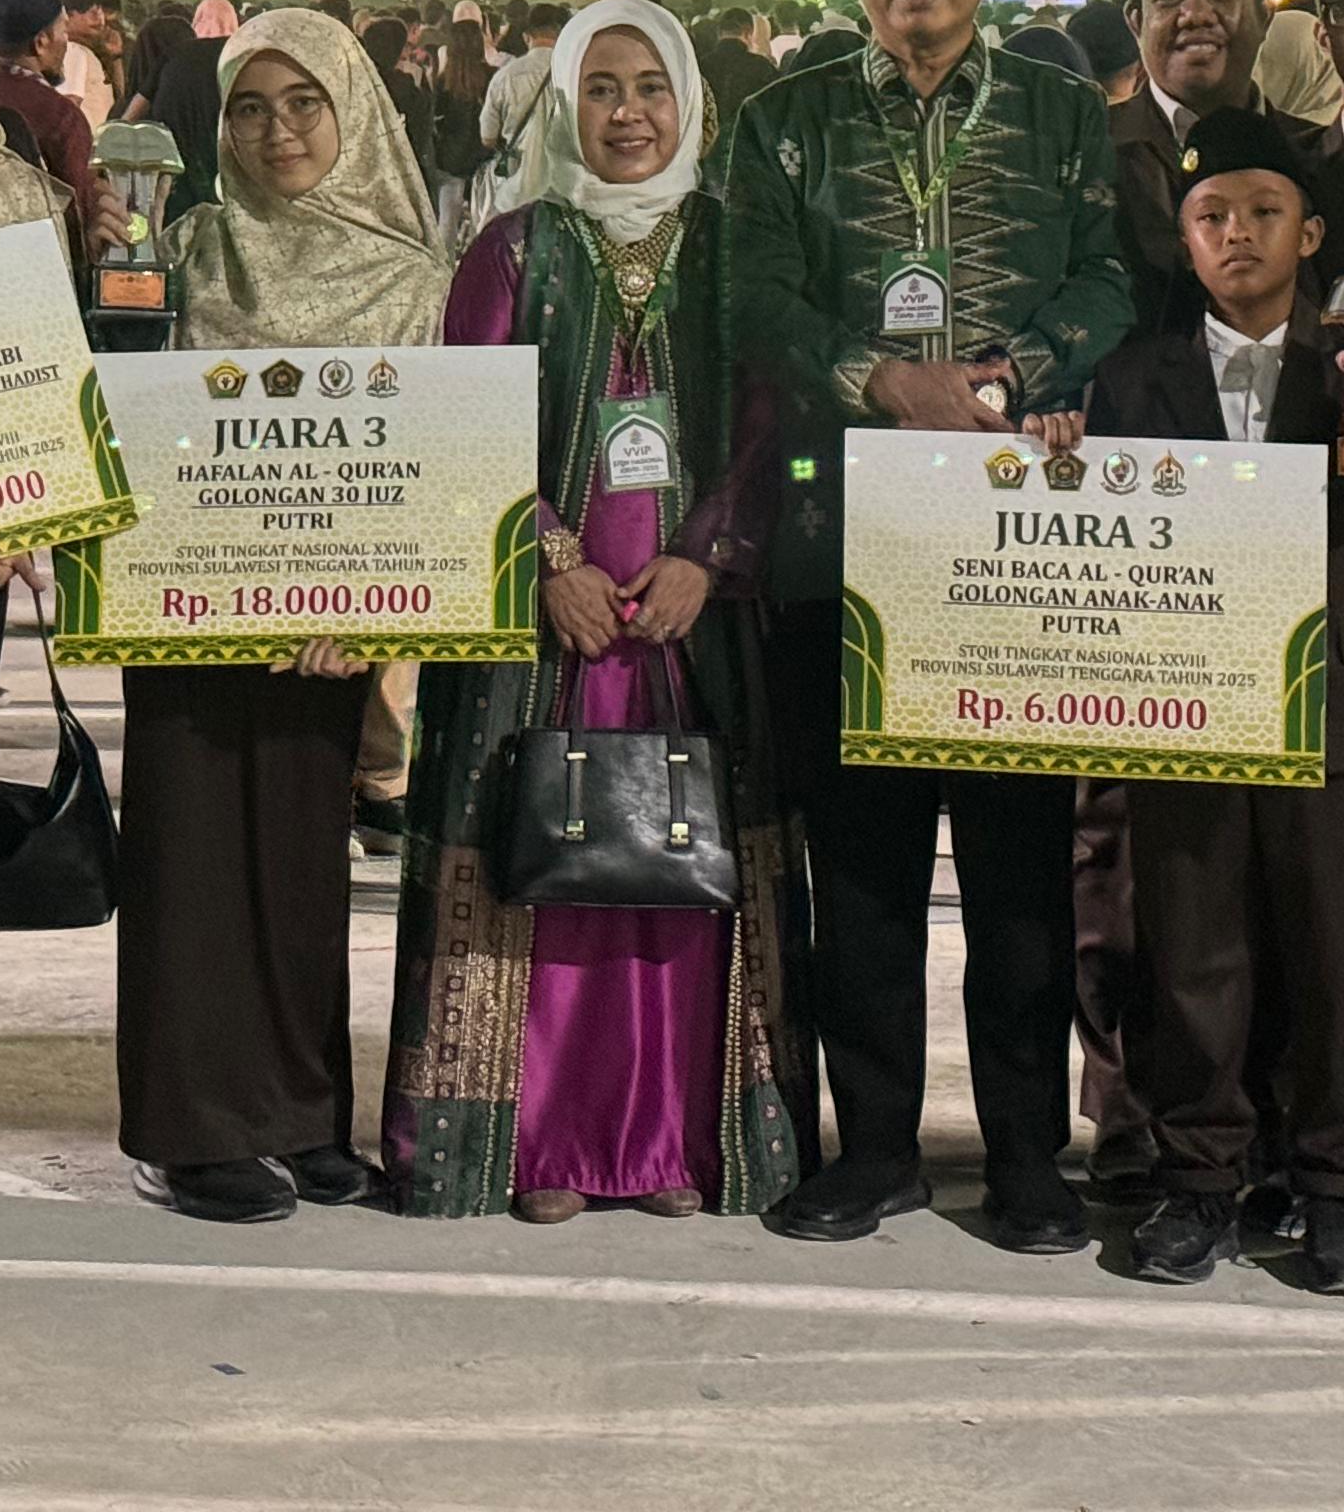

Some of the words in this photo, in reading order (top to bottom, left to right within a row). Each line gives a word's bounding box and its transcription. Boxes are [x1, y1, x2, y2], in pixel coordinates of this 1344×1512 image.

[0, 363, 60, 392] HADIST
[30, 436, 65, 456] 2025
[212, 416, 350, 458] JUARA
[363, 416, 386, 447] 3
[177, 463, 282, 482] HAFALAN
[288, 462, 318, 480] AL
[337, 461, 420, 483] QUR'AN
[198, 486, 325, 505] GOLONGAN
[331, 485, 359, 503] 30
[363, 485, 404, 506] JUZ
[263, 512, 333, 530] PUTRI
[994, 510, 1135, 552] JUARA
[1148, 516, 1173, 550] 3
[175, 544, 216, 561] STQH
[220, 543, 289, 558] TINGKAT
[292, 542, 370, 557] NASIONAL
[372, 541, 419, 555] XXVIII
[127, 561, 199, 576] PROVINSI
[202, 559, 280, 575] SULAWESI
[284, 558, 369, 573] TENGGARA
[371, 557, 425, 572] TAHUN
[429, 557, 467, 571] 2025
[951, 557, 1003, 578] SENI
[1011, 560, 1072, 580] BACA
[1077, 562, 1108, 582] AL
[1128, 564, 1213, 587] QUR'AN
[162, 587, 217, 625] Rp.
[231, 584, 431, 616] 18.000.000
[948, 583, 1076, 606] GOLONGAN
[1082, 589, 1225, 612] ANAK-ANAK
[1041, 614, 1121, 635] PUTRA
[958, 643, 999, 663] STQH
[1003, 645, 1072, 662] TINGKAT
[1075, 648, 1157, 666] NASIONAL
[1158, 652, 1206, 668] XXVIII
[910, 658, 982, 676] PROVINSI
[985, 662, 1064, 679] SULAWESI
[1068, 665, 1155, 683] TENGGARA
[1156, 669, 1213, 685] TAHUN
[1216, 672, 1256, 687] 2025
[957, 688, 1012, 729] Rp.
[1024, 692, 1207, 730] 6.000.000
